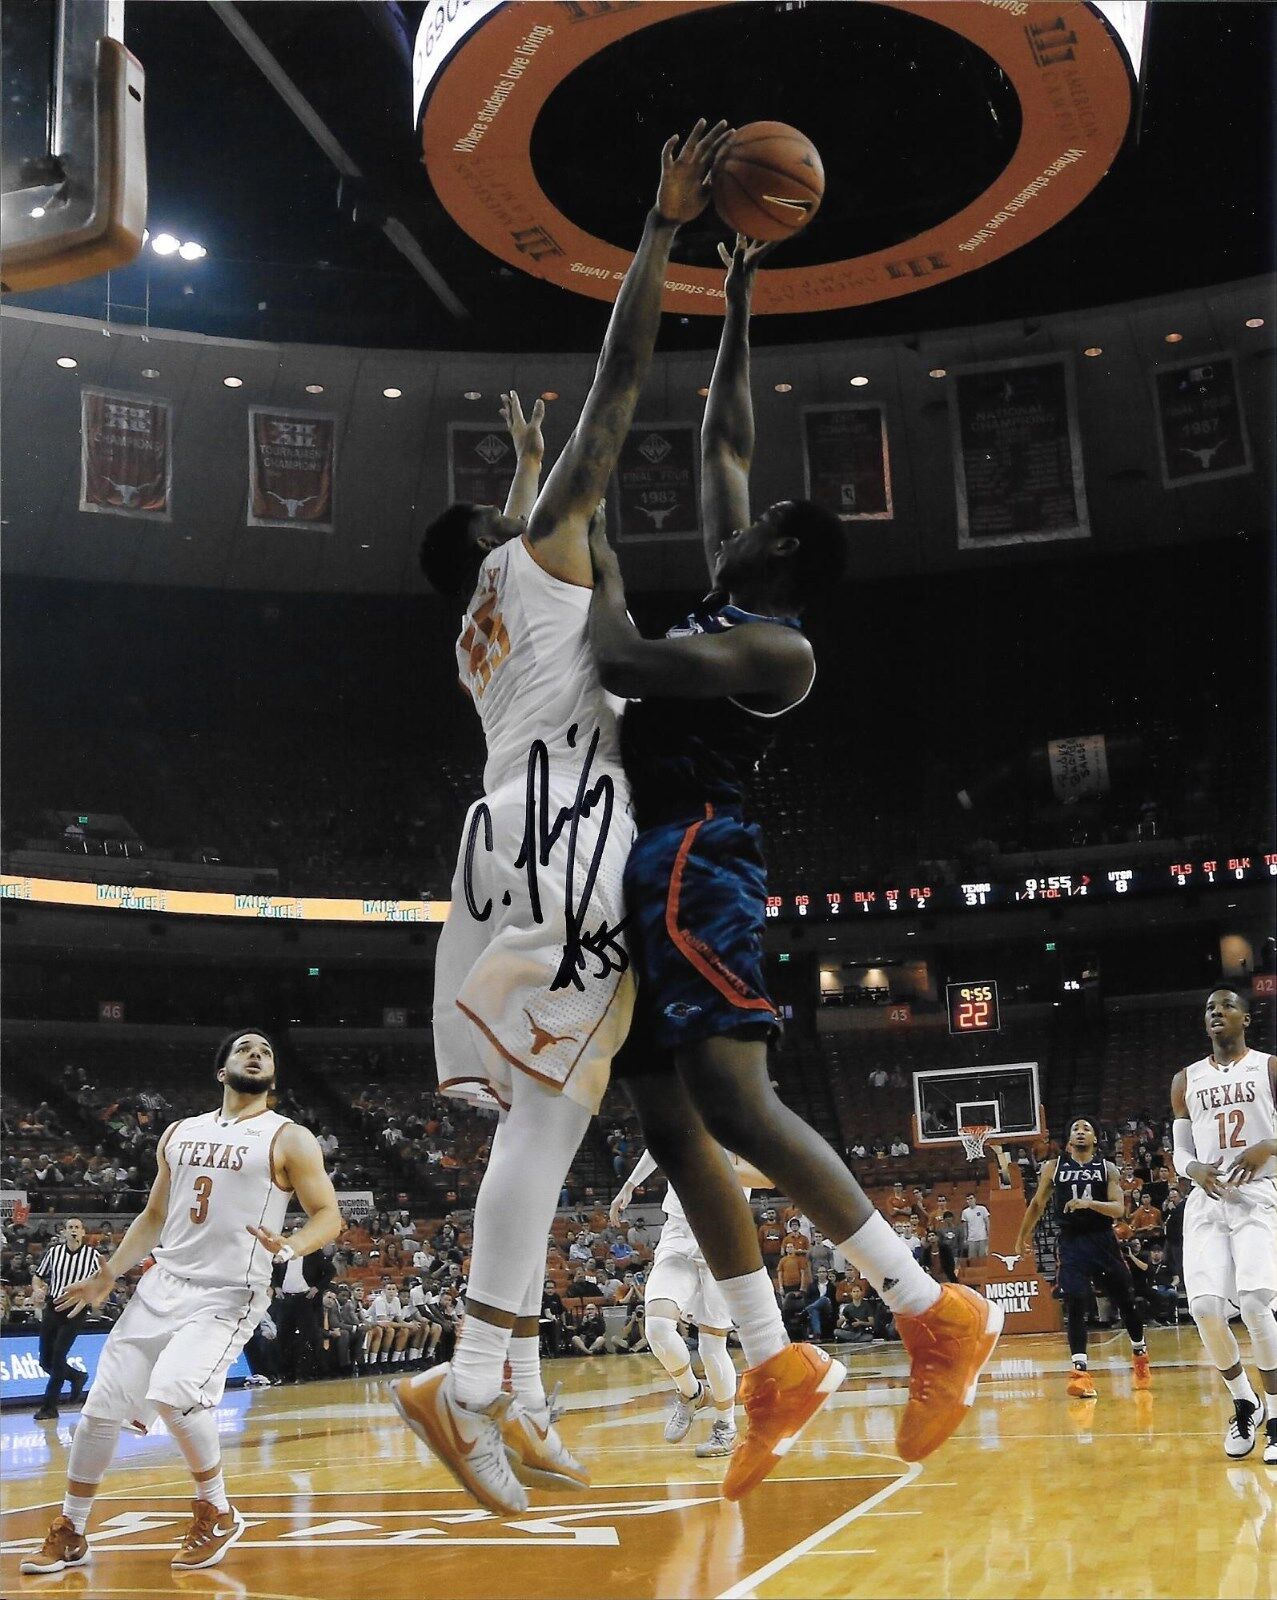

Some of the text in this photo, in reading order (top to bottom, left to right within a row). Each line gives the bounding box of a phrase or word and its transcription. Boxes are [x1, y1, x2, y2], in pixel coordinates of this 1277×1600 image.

[453, 123, 488, 153] Where
[478, 78, 516, 124] students
[500, 55, 530, 80] love
[1043, 148, 1087, 177] Where
[1005, 175, 1050, 213] students
[986, 211, 1016, 230] love
[1182, 418, 1219, 436] 1987
[641, 490, 677, 504] 1982
[1171, 864, 1192, 876] FLS
[1203, 861, 1217, 872] ST
[1229, 858, 1250, 869] BLK
[1025, 875, 1072, 892] 9:55
[1178, 874, 1187, 886] 3
[1209, 871, 1215, 882] 1
[1236, 868, 1244, 880] 0
[97, 884, 135, 900] DAILY
[960, 882, 991, 893] TEXAS
[1039, 889, 1061, 899] TOL
[119, 895, 158, 911] JUICE
[235, 895, 270, 909] DAILY
[767, 896, 781, 907] EB
[795, 895, 810, 906] AS
[854, 891, 876, 903] BLK
[886, 889, 900, 900] ST
[910, 887, 931, 899] FLS
[965, 891, 986, 905] 31
[258, 903, 295, 918] JUICE
[363, 900, 399, 914] DAILY
[386, 908, 422, 922] JUICE
[766, 906, 779, 917] 10
[831, 903, 840, 914] 2
[863, 901, 869, 912] 1
[889, 899, 898, 910] 5
[917, 898, 926, 909] 2
[960, 986, 993, 1002] 9:55
[1255, 979, 1274, 992] 42
[101, 1004, 122, 1020] 46
[386, 1008, 405, 1025] 45
[889, 1008, 908, 1022] 43
[959, 1002, 988, 1028] 22
[1196, 1081, 1256, 1111] TEXAS
[1214, 1109, 1247, 1150] 12
[178, 1140, 249, 1172] TEXAS
[1059, 1169, 1103, 1183] UTSA
[190, 1175, 214, 1225] 3
[1071, 1183, 1093, 1201] 14
[985, 1280, 1039, 1299] MUSCLE
